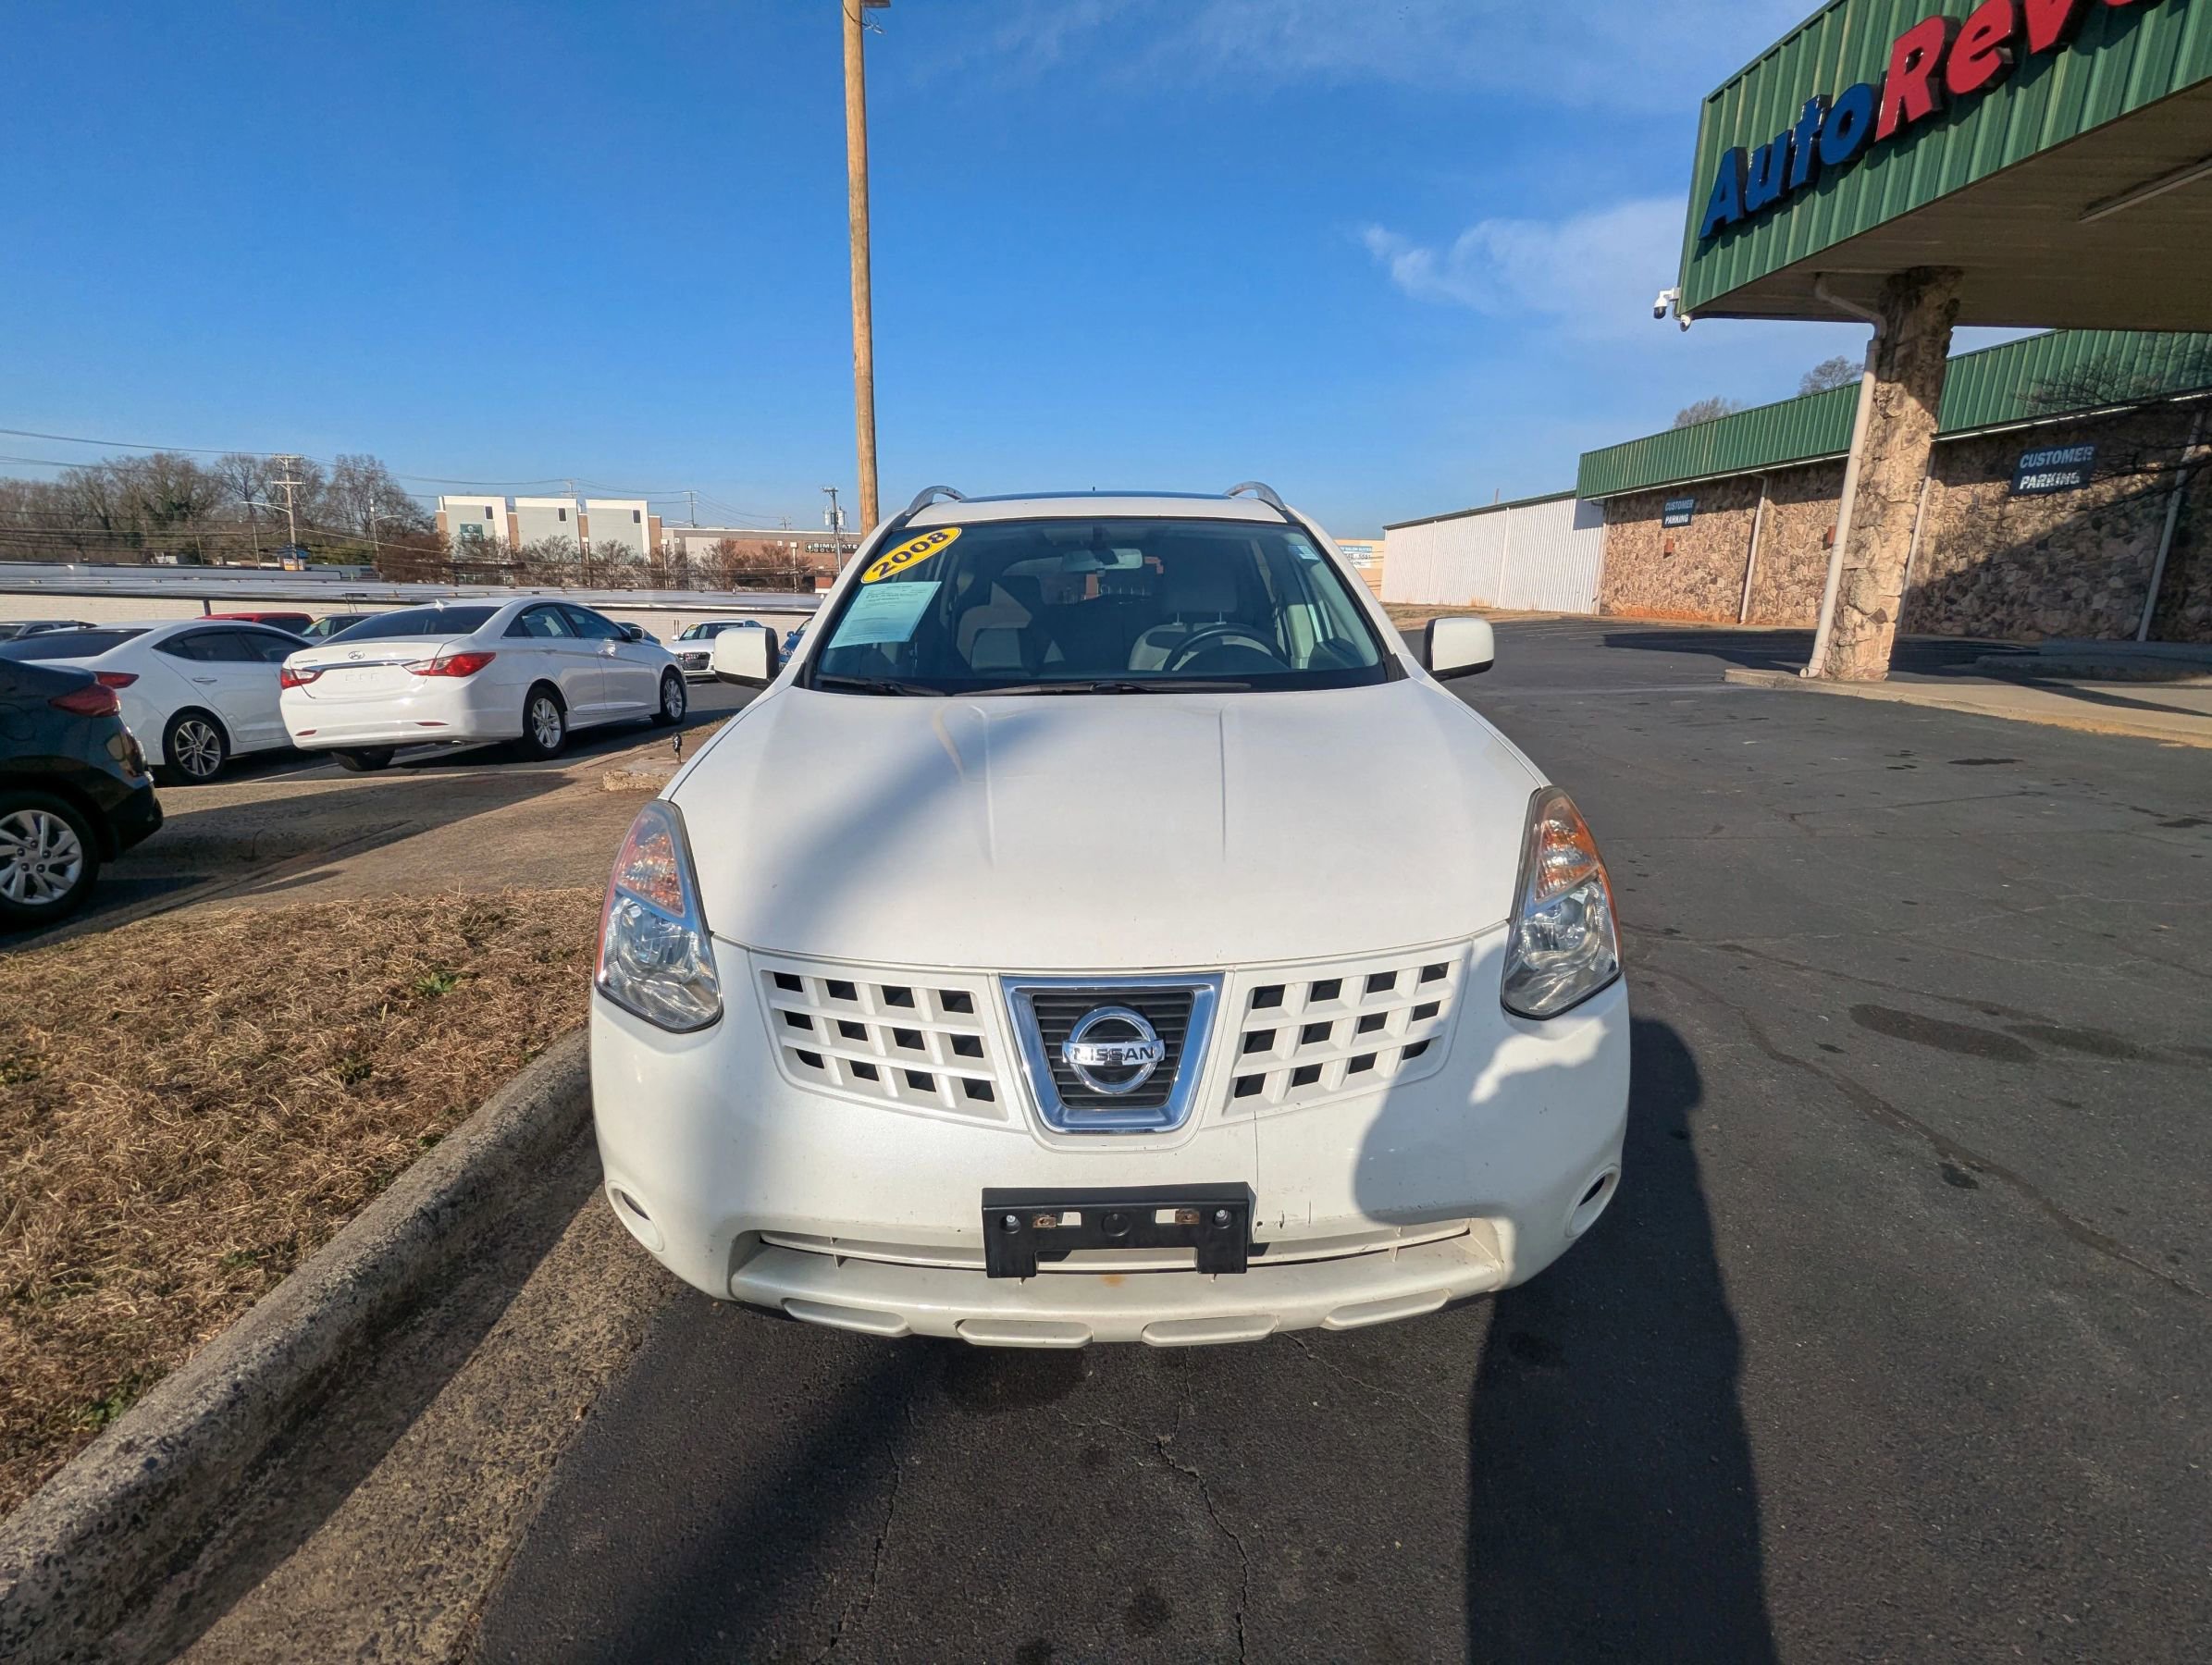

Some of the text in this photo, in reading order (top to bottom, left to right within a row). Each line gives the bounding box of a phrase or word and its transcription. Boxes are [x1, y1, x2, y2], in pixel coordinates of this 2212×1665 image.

[1699, 0, 2133, 240] AutoRev
[2020, 446, 2095, 469] CUSTOMER
[2019, 471, 2081, 490] PARKING
[1665, 500, 1694, 512] CUSTOMER
[1665, 513, 1689, 525] PARKING
[872, 532, 951, 577] 2008
[1073, 1046, 1155, 1062] NISSAN
